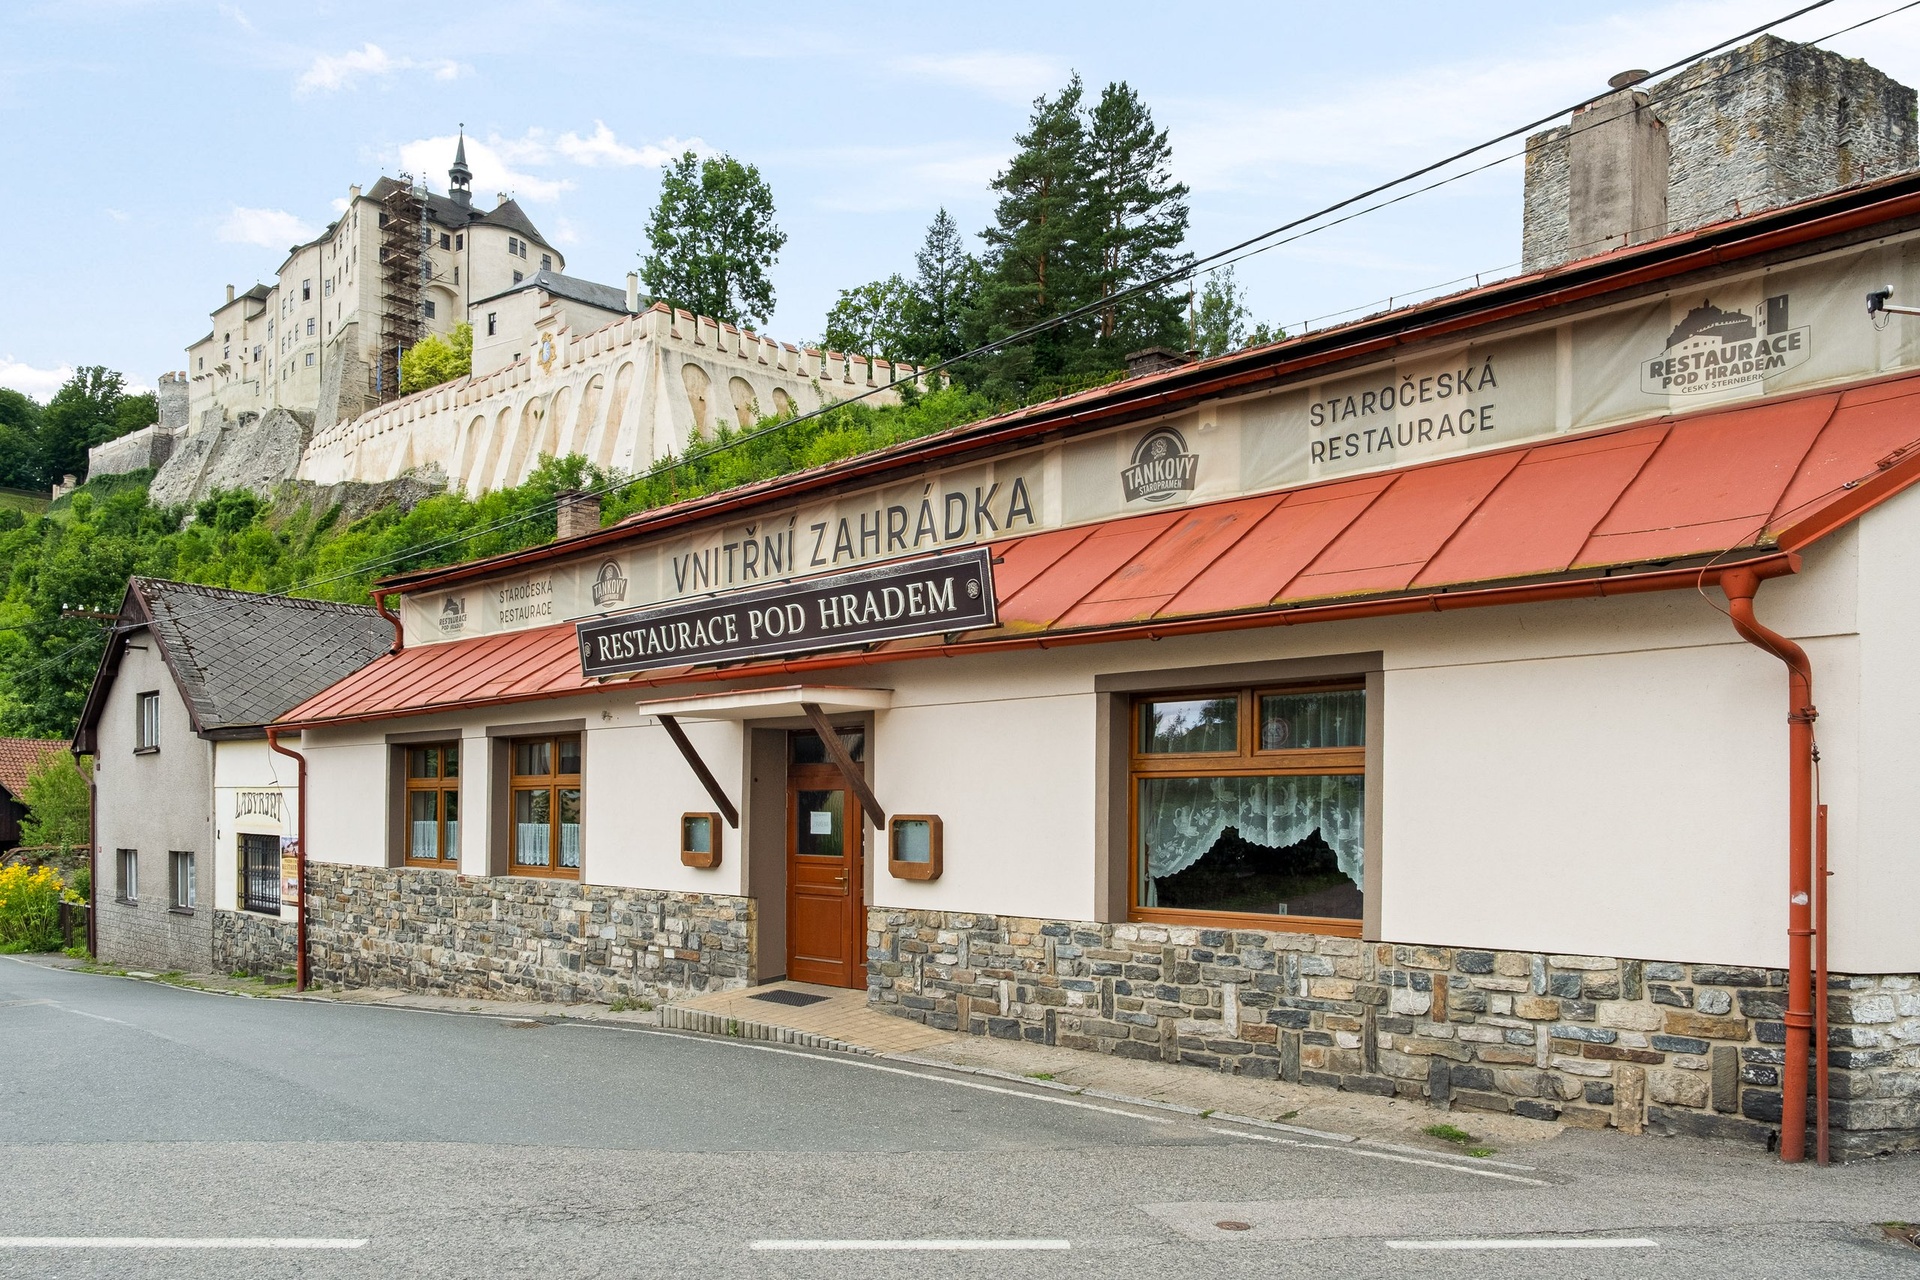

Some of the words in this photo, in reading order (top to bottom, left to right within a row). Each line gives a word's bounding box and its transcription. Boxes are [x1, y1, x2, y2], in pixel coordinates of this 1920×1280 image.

[1650, 332, 1801, 379] RESTAURACE
[1662, 371, 1698, 389] POD
[1705, 354, 1786, 381] HRADEM
[1310, 355, 1498, 427] STAROČESKÁ
[1681, 382, 1710, 394] ČESKÝ
[1711, 372, 1765, 389] ŠTERNBERK
[1311, 404, 1496, 465] RESTAURACE
[1125, 455, 1195, 490] TANKOVÝ
[1139, 479, 1183, 496] STAROPRAMEN
[673, 515, 798, 594] VNITŘNÍ
[810, 477, 1035, 567] ZAHRÁDKA
[499, 576, 553, 604] STAROČESKÁ
[499, 601, 553, 624] RESTAURACE
[598, 613, 739, 661] RESTAURACE
[748, 602, 806, 640] POD
[818, 577, 958, 630] HRADEM
